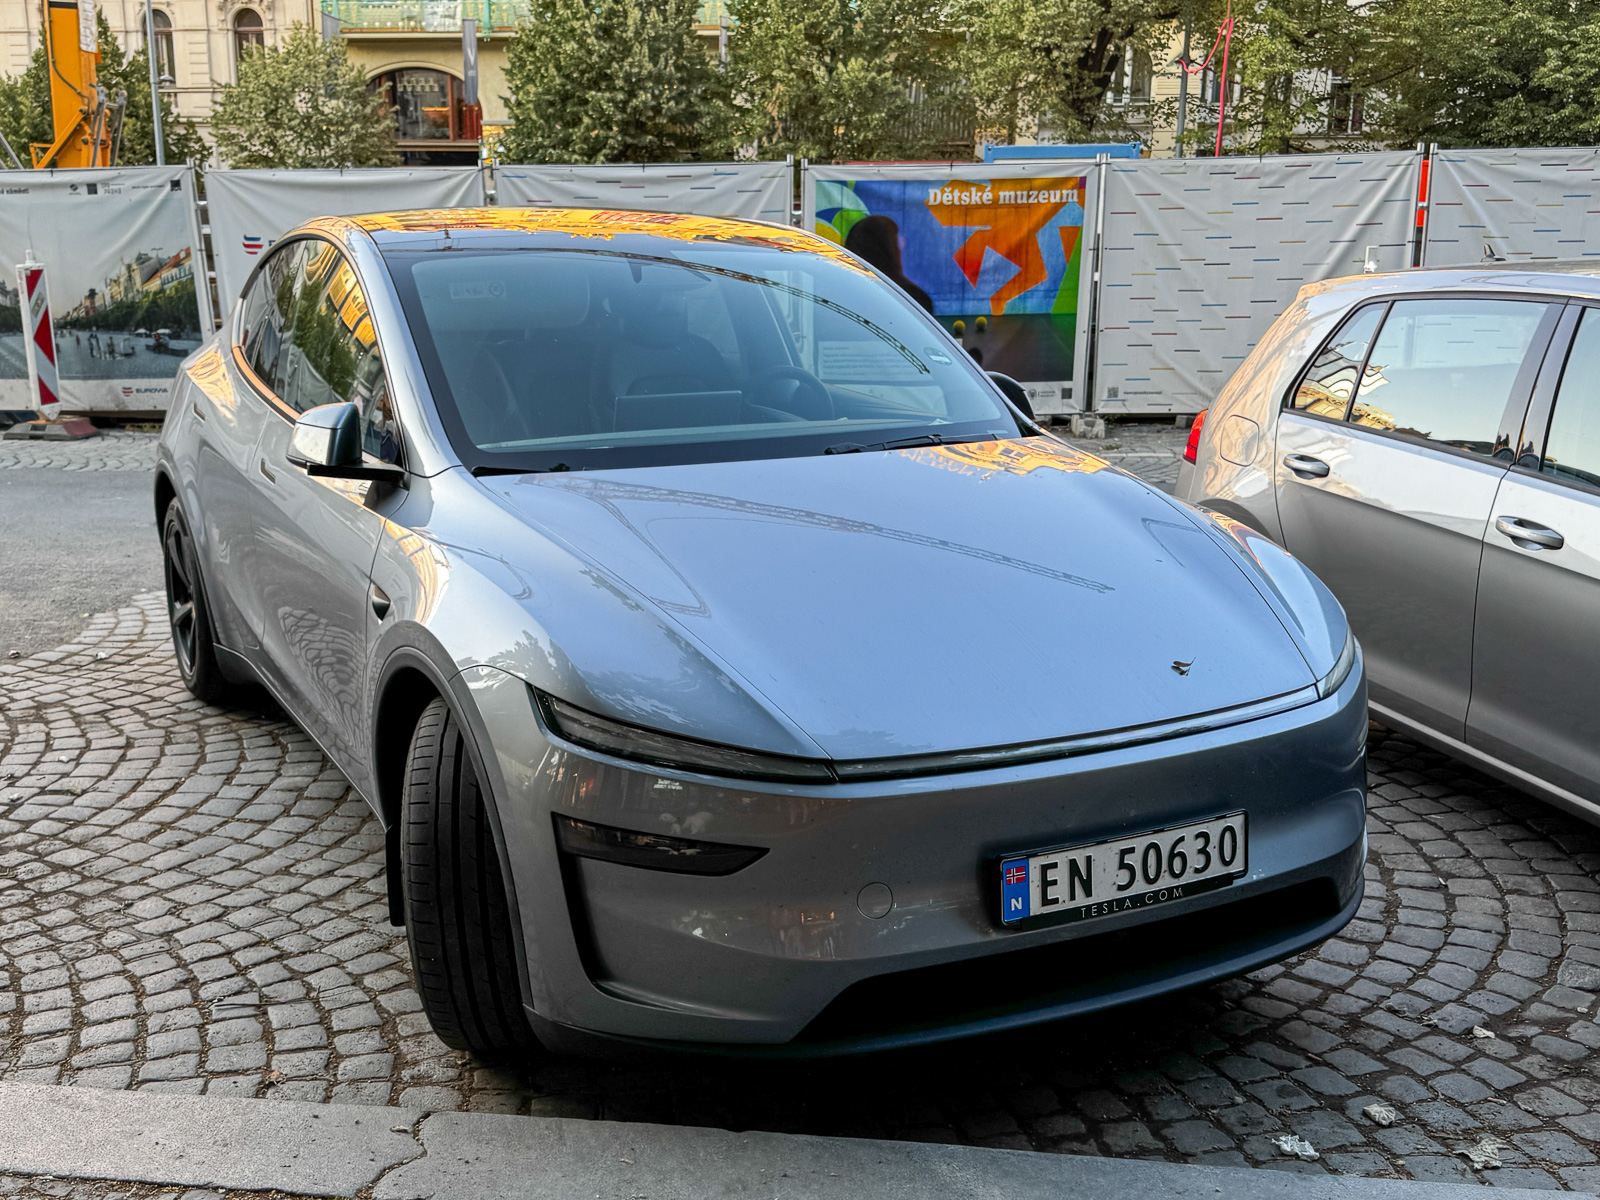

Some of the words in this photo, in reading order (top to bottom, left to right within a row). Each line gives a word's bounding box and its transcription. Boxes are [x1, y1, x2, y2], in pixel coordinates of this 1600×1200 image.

[928, 186, 993, 206] Dětské
[998, 189, 1078, 205] muzeum
[1040, 854, 1093, 907] EN
[1116, 824, 1238, 891] 50630
[1010, 896, 1023, 911] N
[1081, 887, 1184, 919] TESLA.COM
